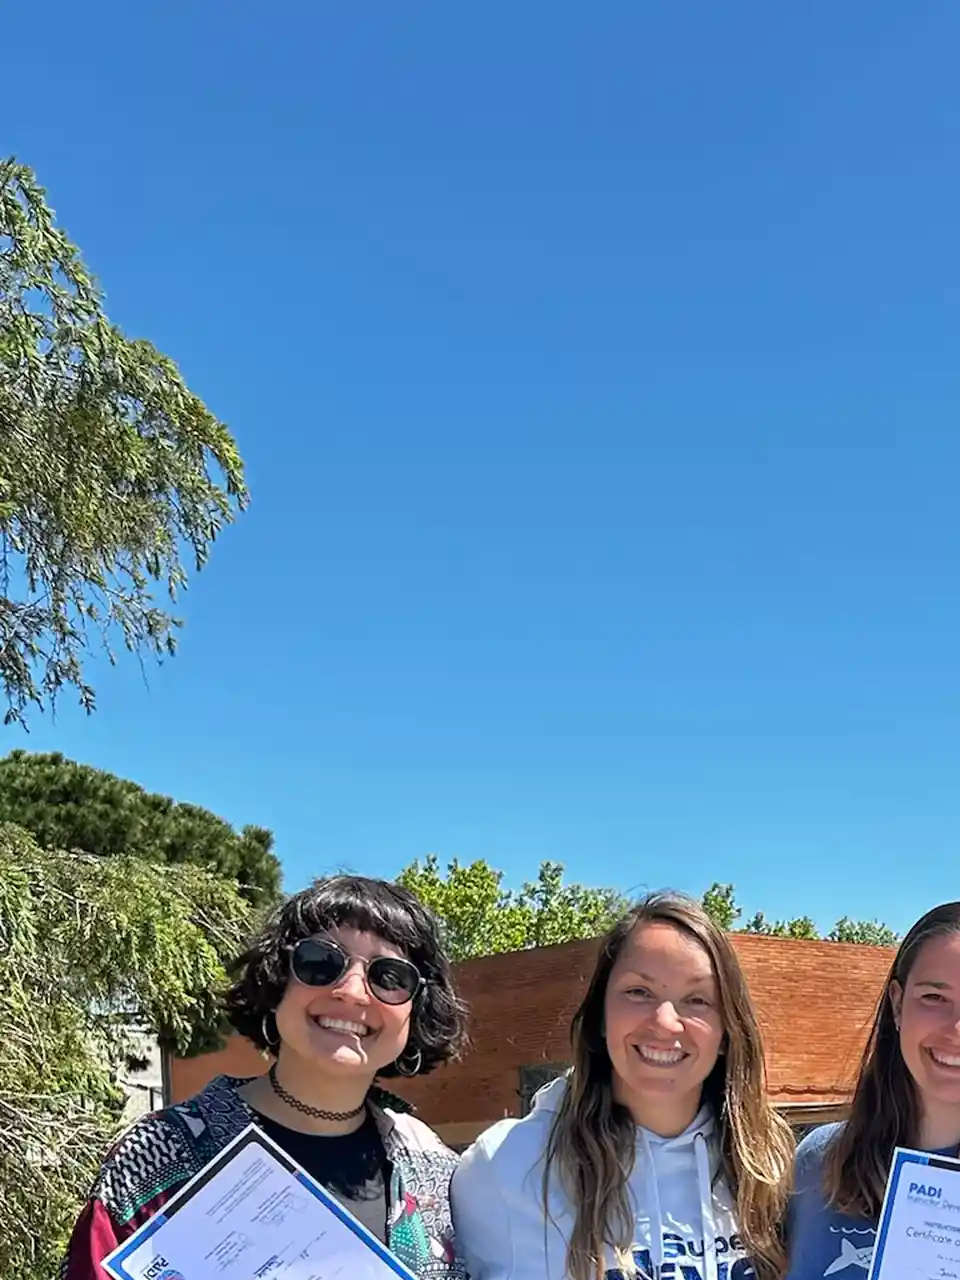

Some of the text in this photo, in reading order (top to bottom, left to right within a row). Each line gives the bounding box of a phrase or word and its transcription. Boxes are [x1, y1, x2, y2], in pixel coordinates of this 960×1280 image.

[909, 1182, 942, 1199] PADI
[905, 1226, 952, 1244] Certificate
[662, 1233, 745, 1258] Supe
